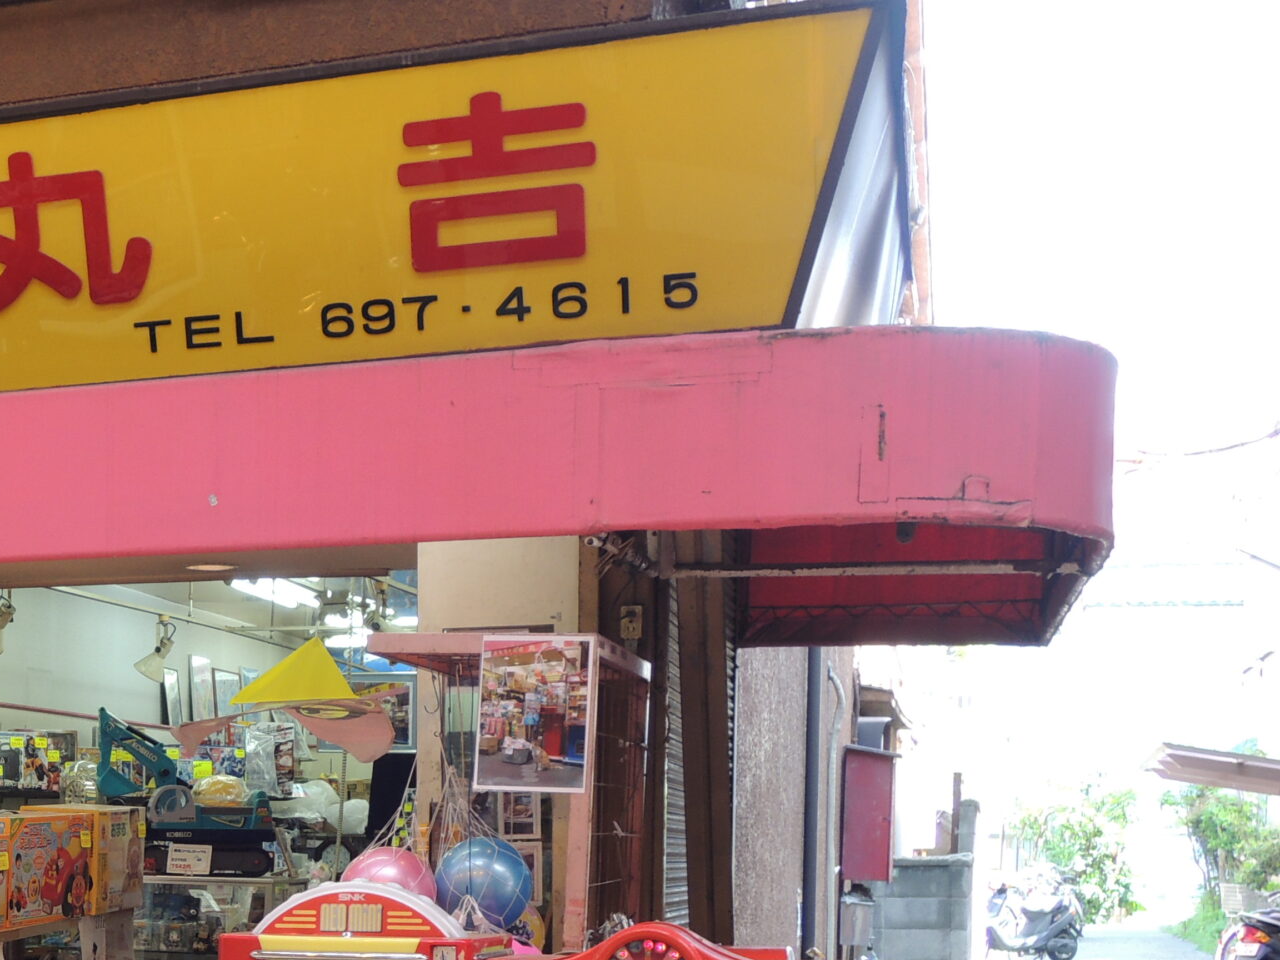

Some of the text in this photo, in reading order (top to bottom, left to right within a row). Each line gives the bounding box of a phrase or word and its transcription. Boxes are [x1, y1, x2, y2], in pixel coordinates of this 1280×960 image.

[134, 311, 274, 353] TEL
[131, 740, 159, 762] KOBELCO
[338, 893, 367, 901] SNK
